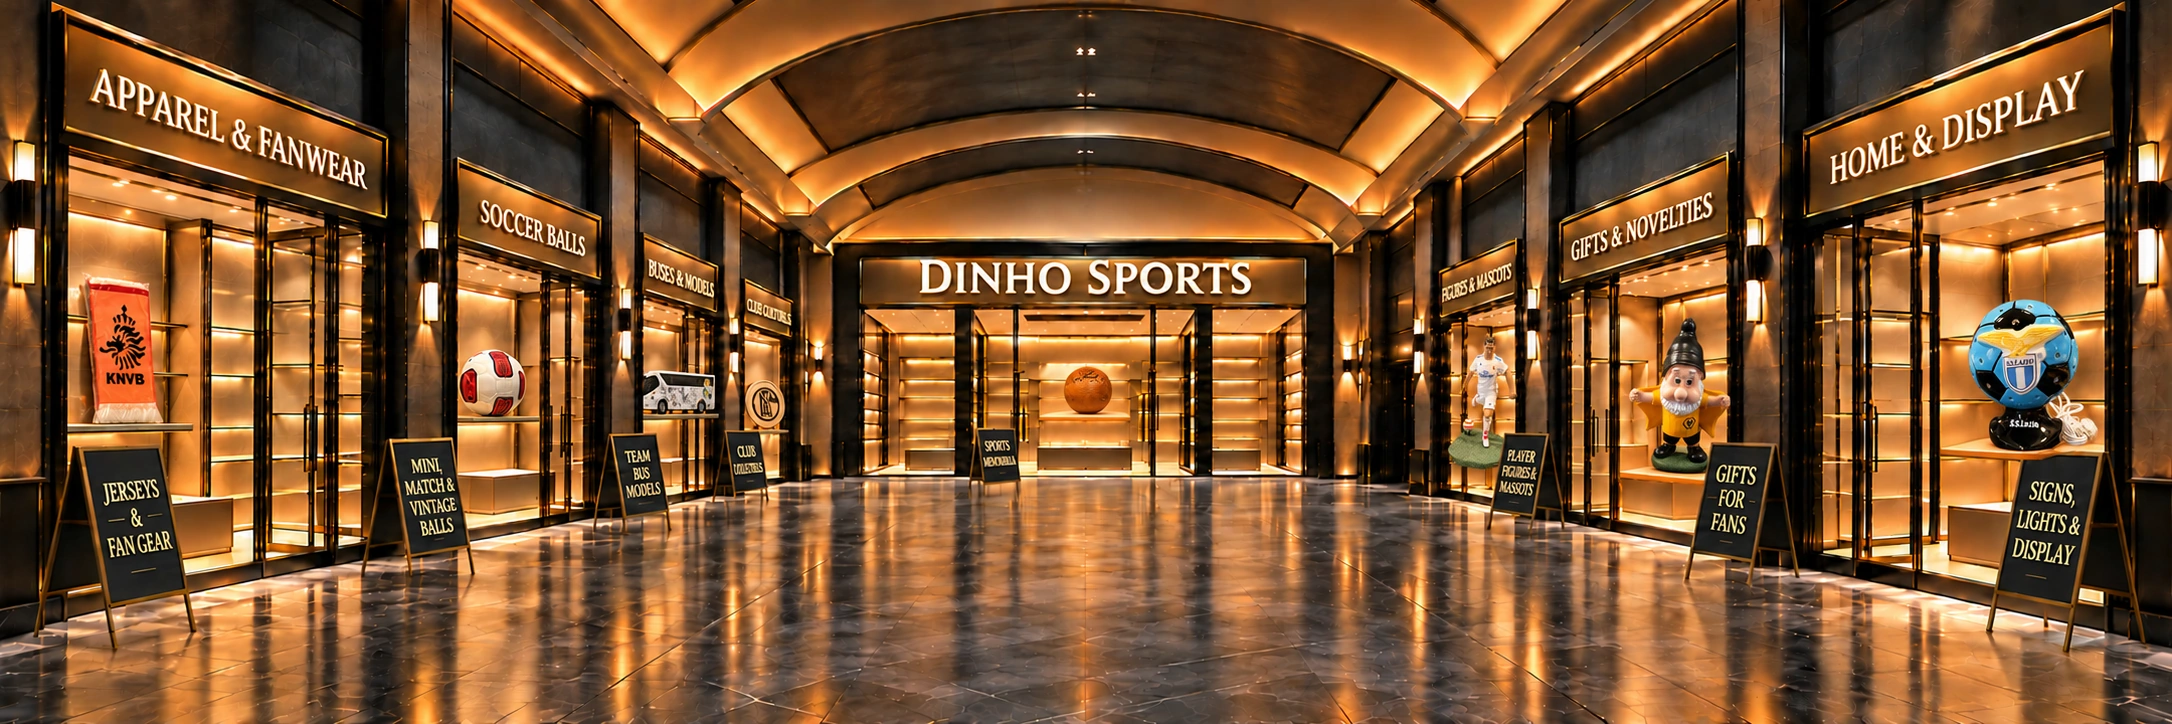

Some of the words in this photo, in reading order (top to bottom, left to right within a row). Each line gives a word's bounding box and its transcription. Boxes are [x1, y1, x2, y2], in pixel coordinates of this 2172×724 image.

[90, 68, 225, 143] APPAREL
[231, 118, 252, 153] &
[257, 125, 368, 190] FANWEAR
[1829, 131, 1905, 184] HOME
[1912, 124, 1935, 157] &
[1942, 70, 2085, 150] DISPLAY
[480, 199, 544, 244] SOCCER
[546, 223, 586, 257] BALLS
[1571, 228, 1608, 261] GIFTS
[1611, 225, 1622, 247] &
[1626, 192, 1713, 243] NOVELTIES
[648, 259, 675, 285] BUSES
[676, 269, 684, 288] &
[685, 272, 715, 298] MODELS
[919, 259, 1072, 295] DINHO
[1088, 260, 1252, 295] SPORTS
[1441, 279, 1468, 303] FIGURES
[1468, 277, 1475, 294] &
[1476, 262, 1512, 291] MASCOTS
[106, 372, 145, 385] KNVB
[624, 449, 651, 463] TEAM
[984, 440, 1011, 452] SPORTS
[1506, 449, 1536, 463] PLAYER
[410, 457, 443, 475] MINI,
[632, 466, 651, 481] BUS
[1530, 466, 1538, 480] &
[1715, 464, 1758, 486] GIFTS
[102, 478, 160, 506] JERSEYS
[404, 477, 446, 496] MATCH
[446, 477, 456, 492] &
[625, 481, 662, 499] MODELS
[2028, 480, 2076, 509] SIGNS,
[408, 497, 458, 517] VINTAGE
[1717, 488, 1746, 509] FOR
[130, 507, 144, 528] &
[419, 517, 455, 537] BALLS
[1710, 511, 1747, 535] FANS
[2016, 509, 2068, 535] LIGHTS
[2068, 515, 2081, 536] &
[106, 535, 136, 558] FAN
[136, 530, 174, 554] GEAR
[2011, 537, 2076, 566] DISPLAY
